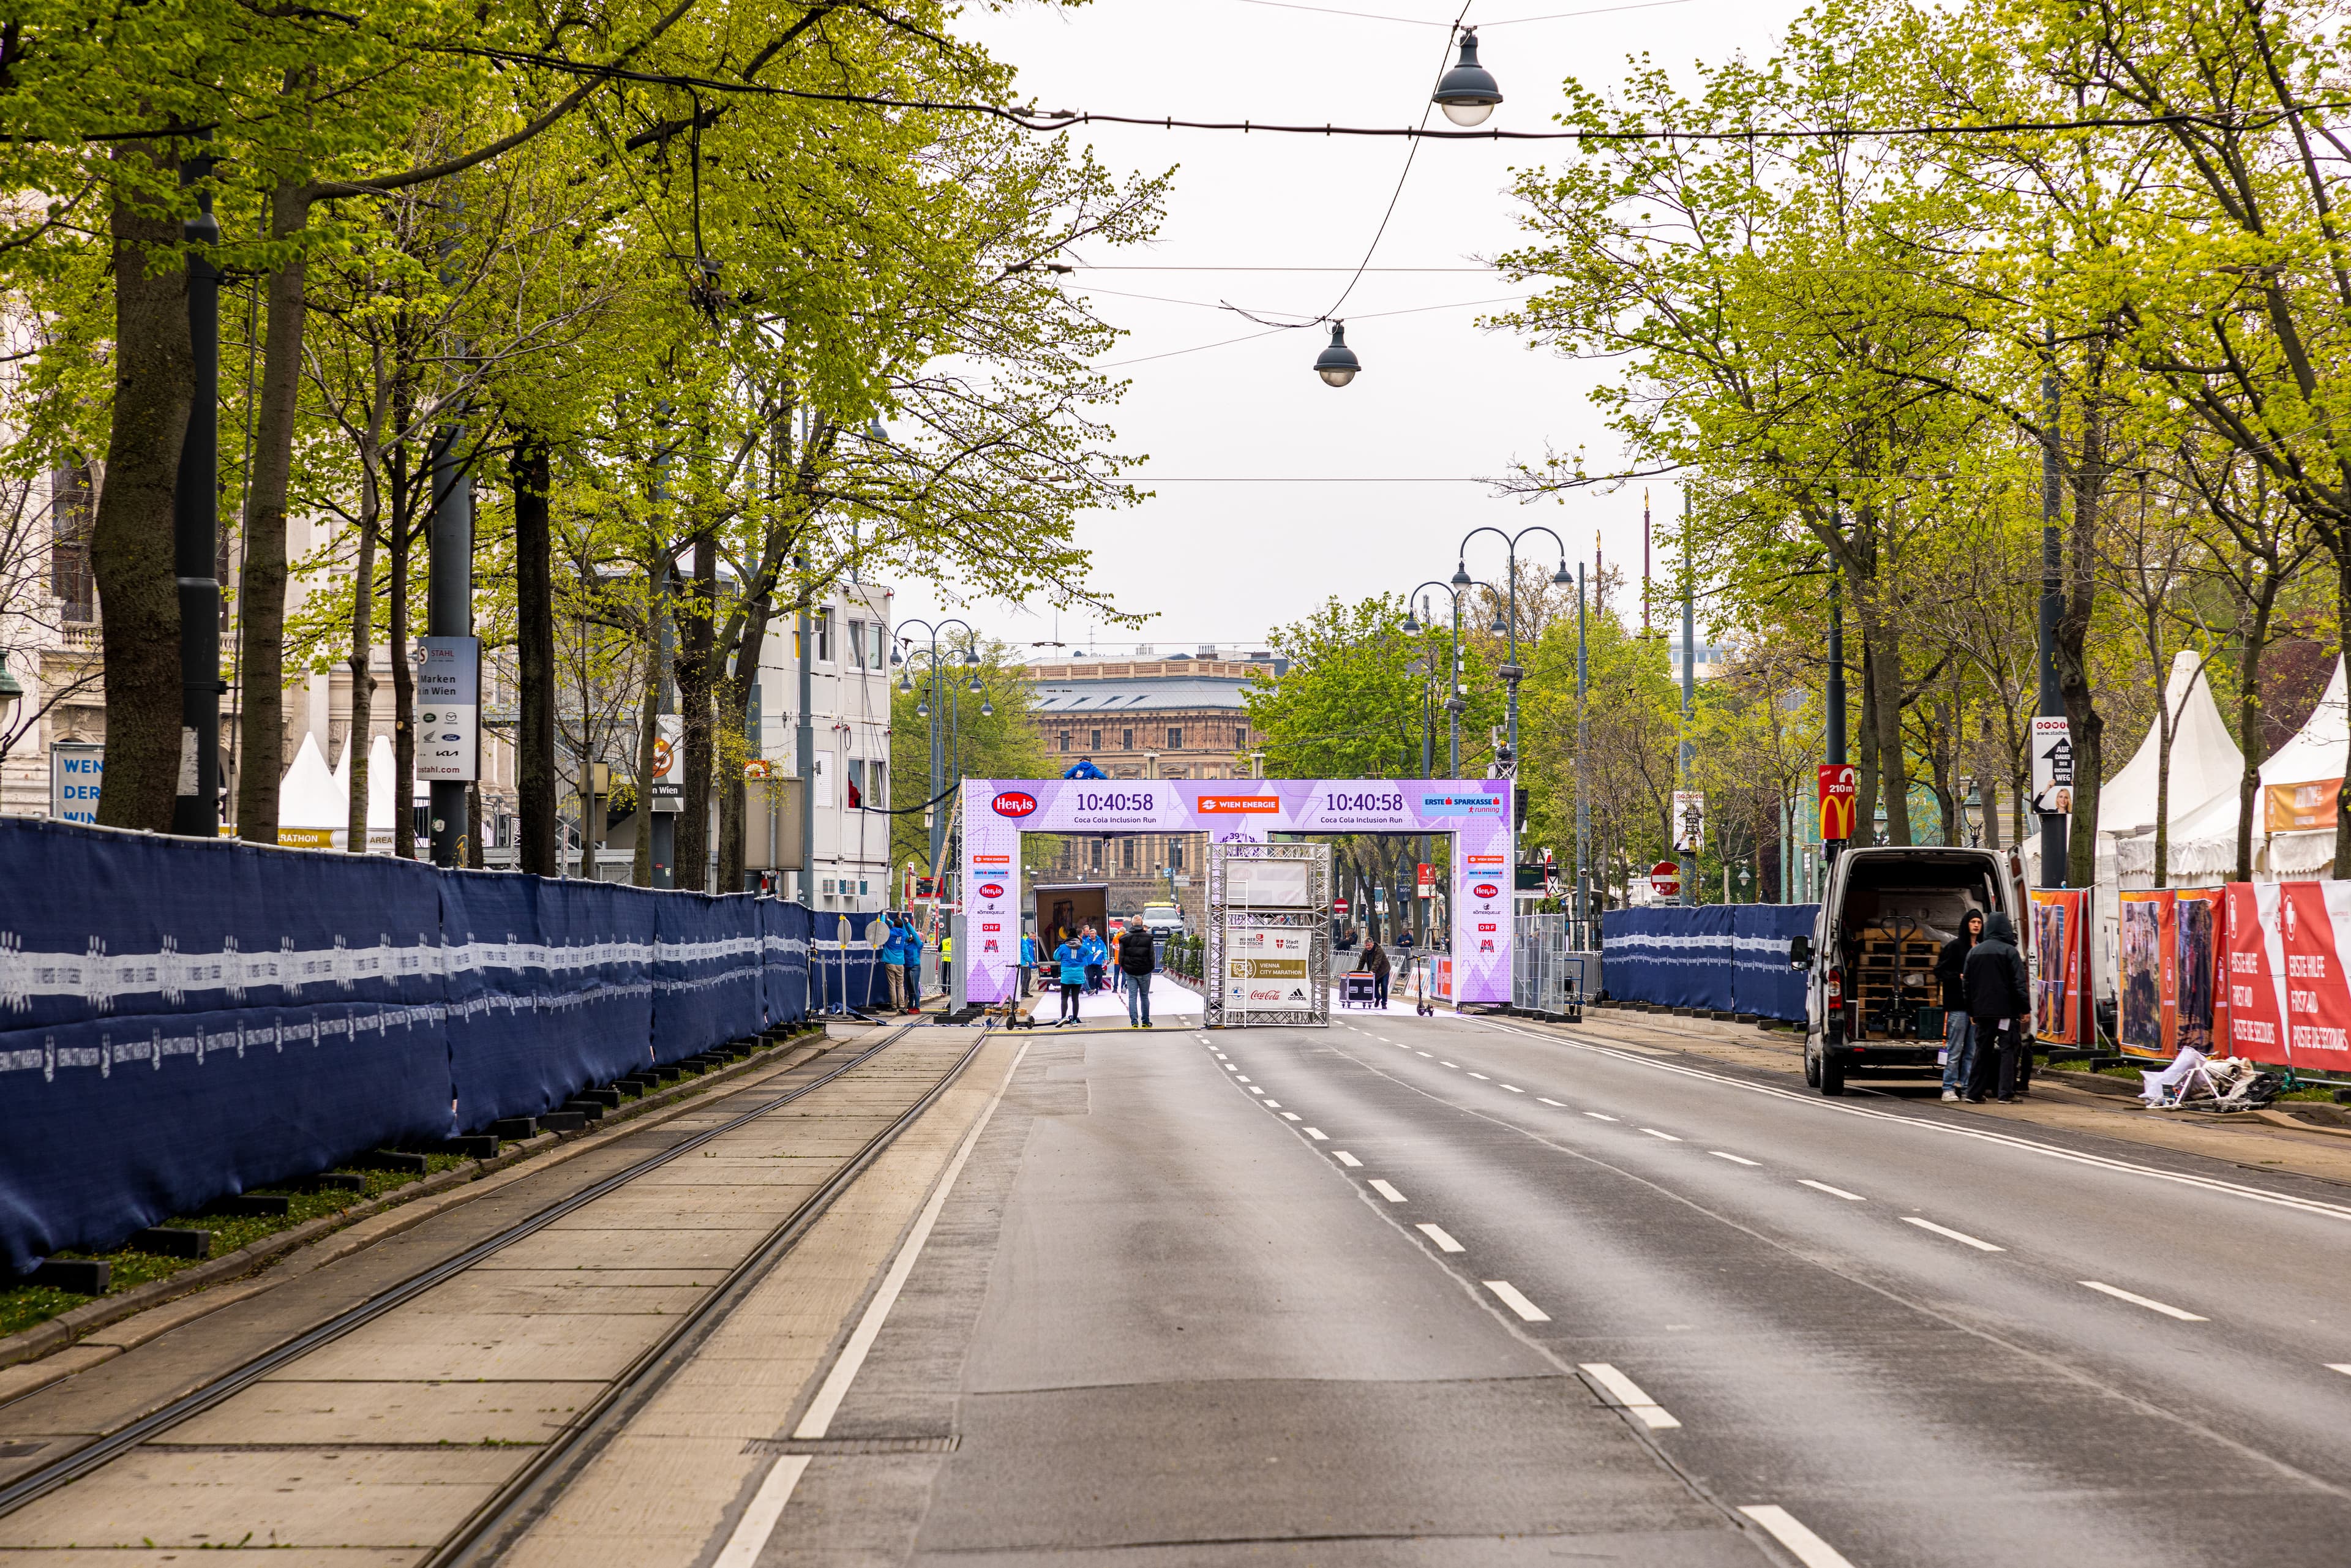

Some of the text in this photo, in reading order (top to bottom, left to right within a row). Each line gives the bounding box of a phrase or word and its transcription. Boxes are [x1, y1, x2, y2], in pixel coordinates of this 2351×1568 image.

[64, 785, 101, 800] DER
[997, 797, 1033, 812] Hervis
[1077, 793, 1153, 811] 10:40:58
[1327, 793, 1403, 811] 10:40:58
[981, 887, 1002, 896] Hervis
[1476, 887, 1496, 896] Hervis
